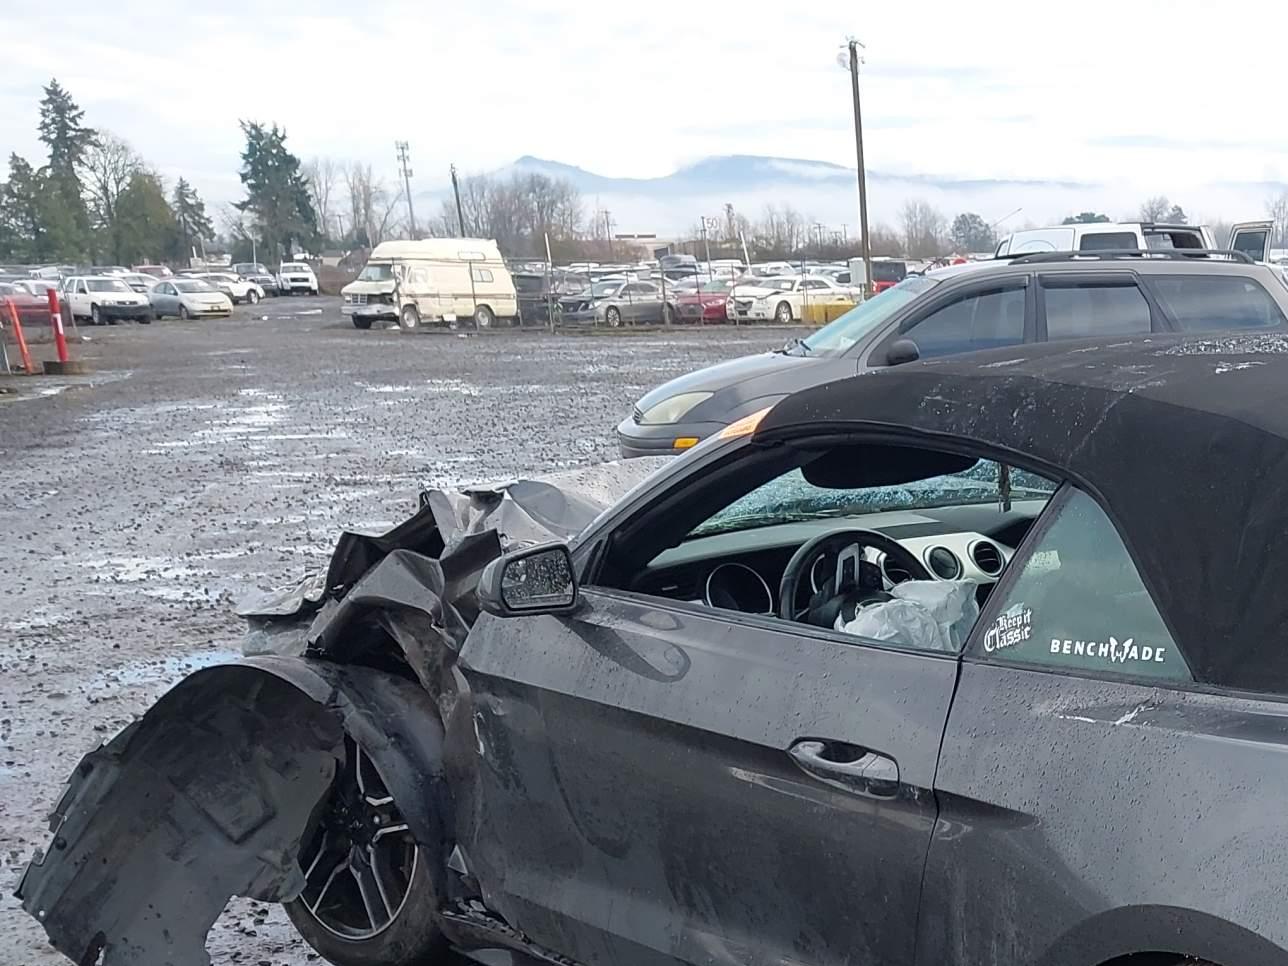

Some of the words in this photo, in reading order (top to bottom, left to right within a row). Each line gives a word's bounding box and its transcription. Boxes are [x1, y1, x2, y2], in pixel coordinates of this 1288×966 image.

[996, 614, 1022, 630] Keep
[1022, 608, 1032, 624] it
[984, 625, 1031, 652] Classic
